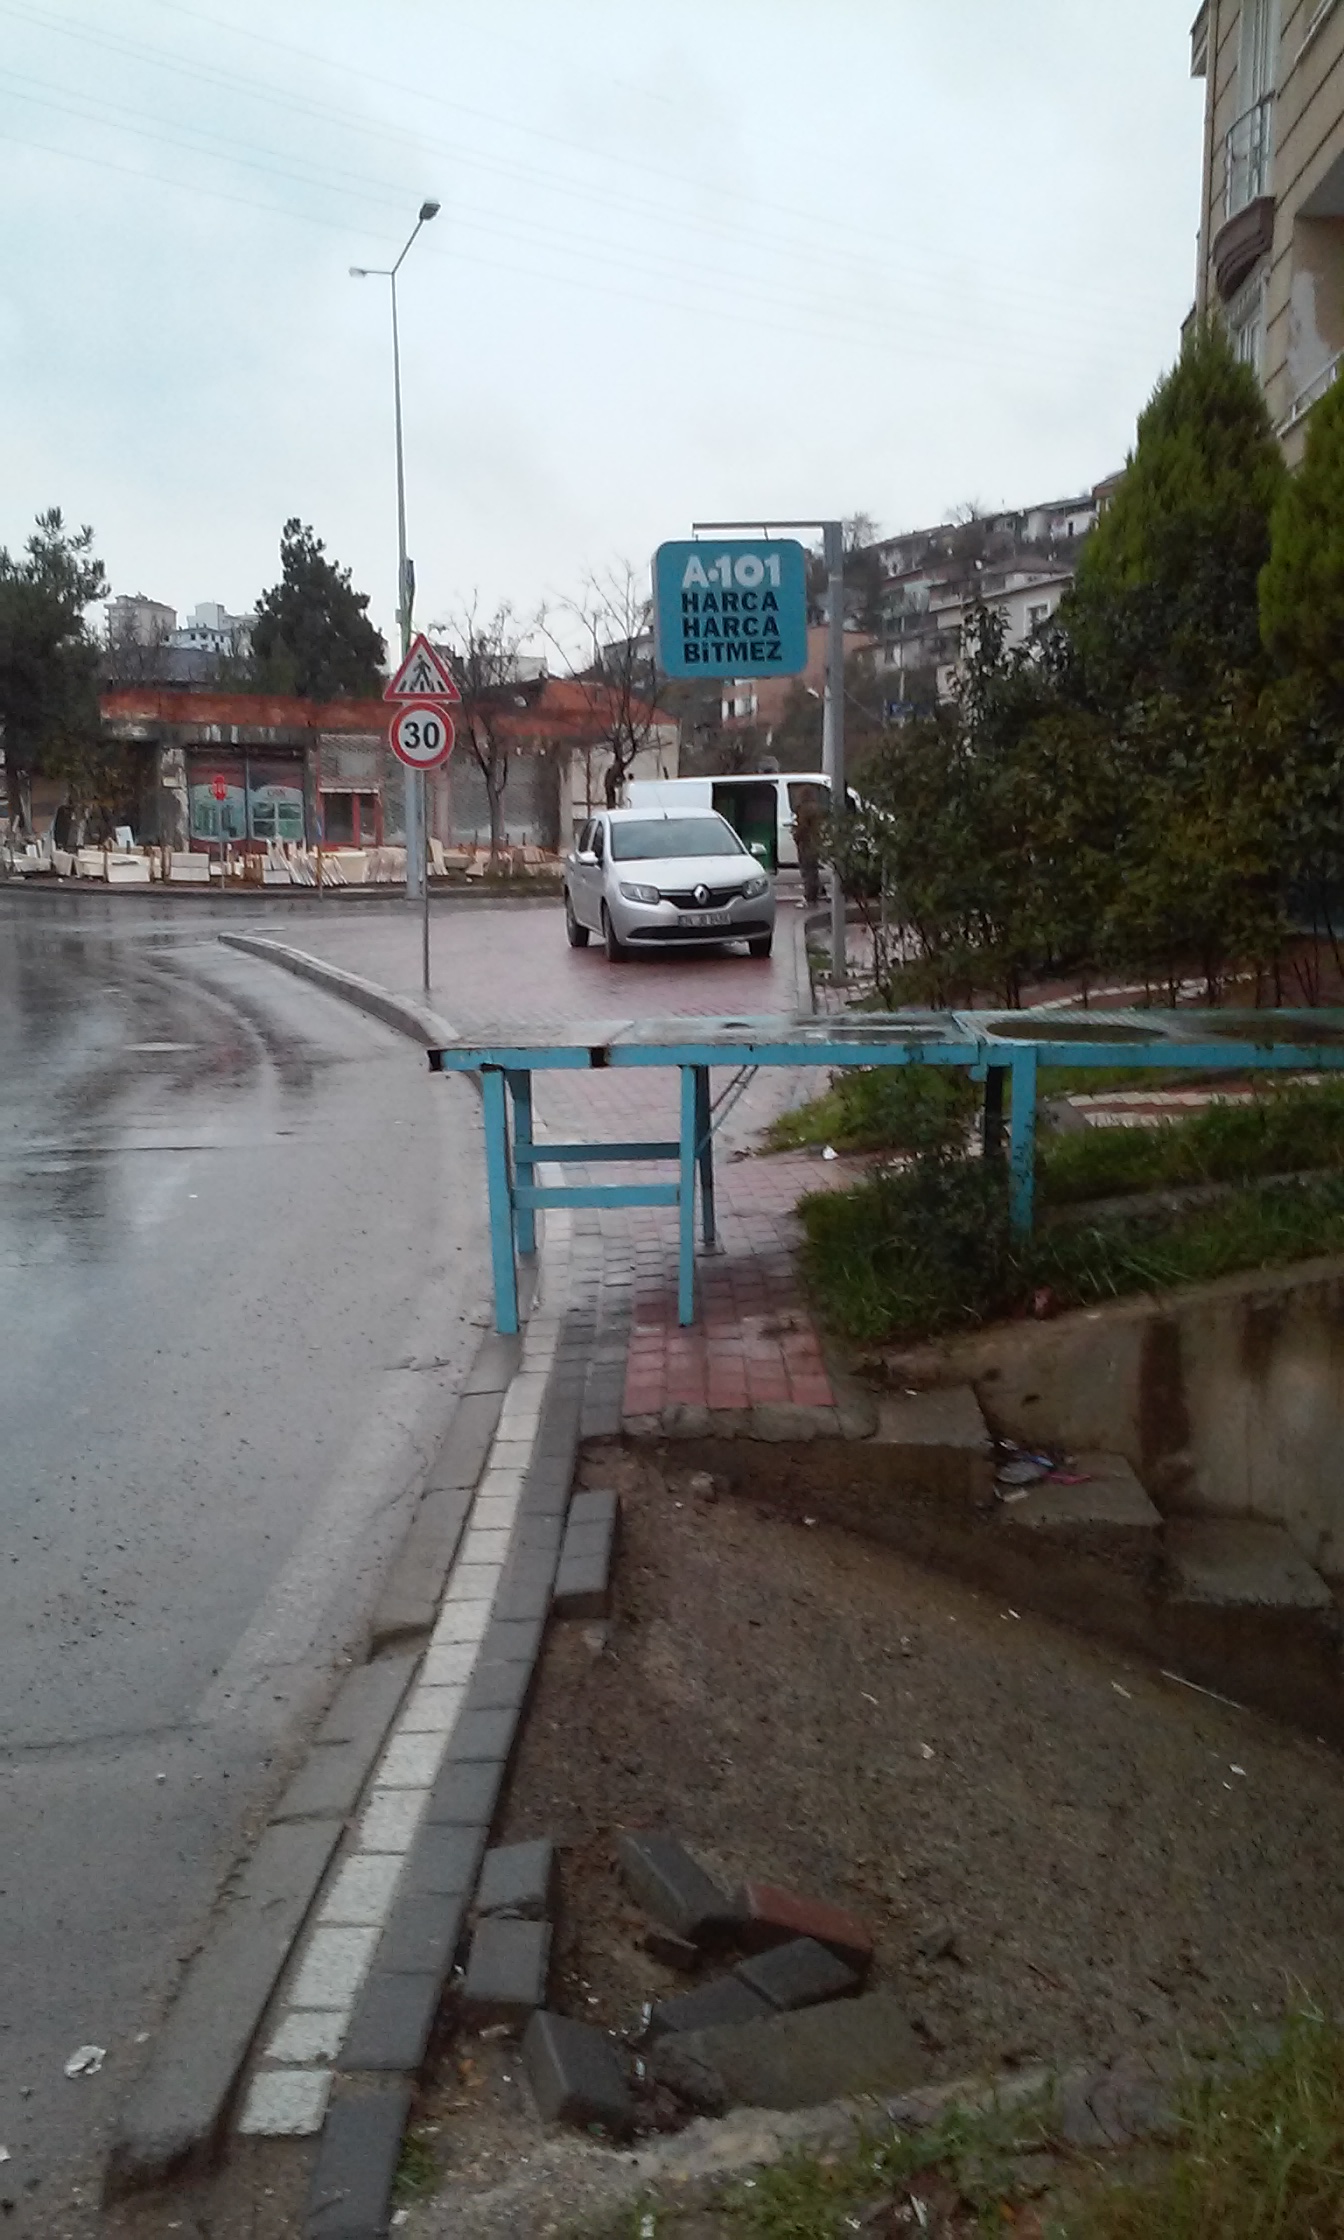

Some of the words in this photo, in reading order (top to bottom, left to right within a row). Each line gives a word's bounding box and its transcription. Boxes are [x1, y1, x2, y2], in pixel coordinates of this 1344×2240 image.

[681, 590, 779, 613] HARCA
[682, 616, 780, 638] HARCA
[404, 721, 440, 749] 30
